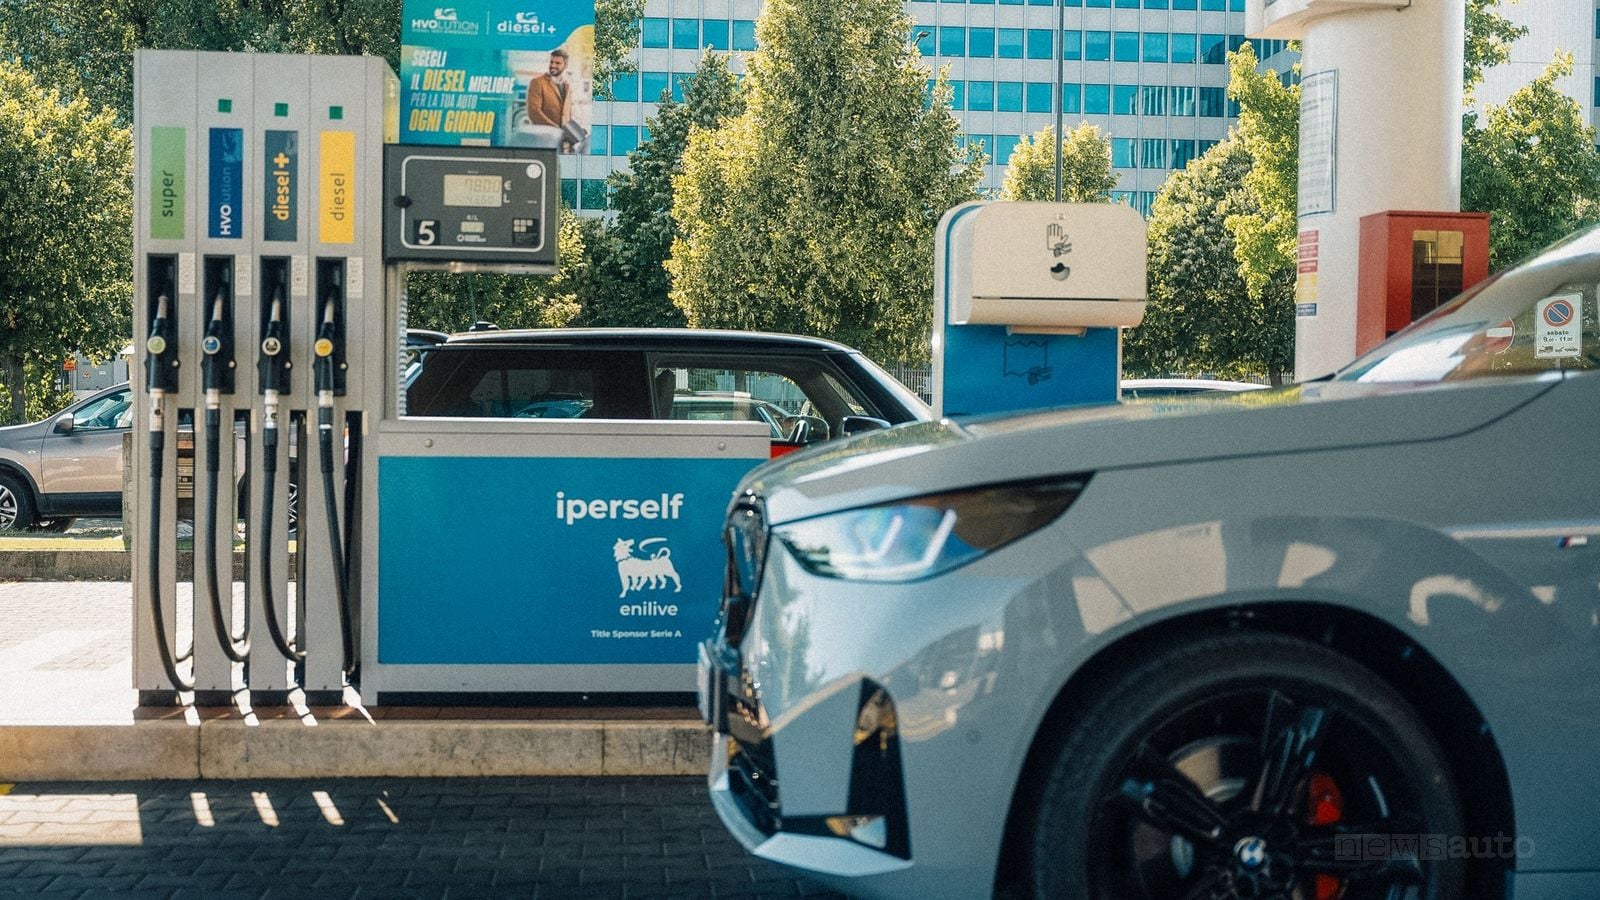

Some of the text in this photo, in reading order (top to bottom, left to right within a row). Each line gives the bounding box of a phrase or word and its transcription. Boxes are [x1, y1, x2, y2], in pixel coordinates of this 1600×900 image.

[412, 19, 479, 31] HVOLUTION
[412, 50, 447, 67] SCEGLI
[411, 69, 516, 94] IL DIESEL MIGLIORE
[411, 93, 478, 109] PER LA TUA AUTO
[409, 109, 495, 134] OGNI GIORNO
[162, 170, 177, 217] super
[329, 172, 345, 221] diesel
[503, 192, 511, 203] L
[418, 220, 436, 246] 5
[556, 491, 684, 525] iperself
[619, 601, 678, 616] enilive
[590, 629, 682, 640] Title Sponsor Serie A
